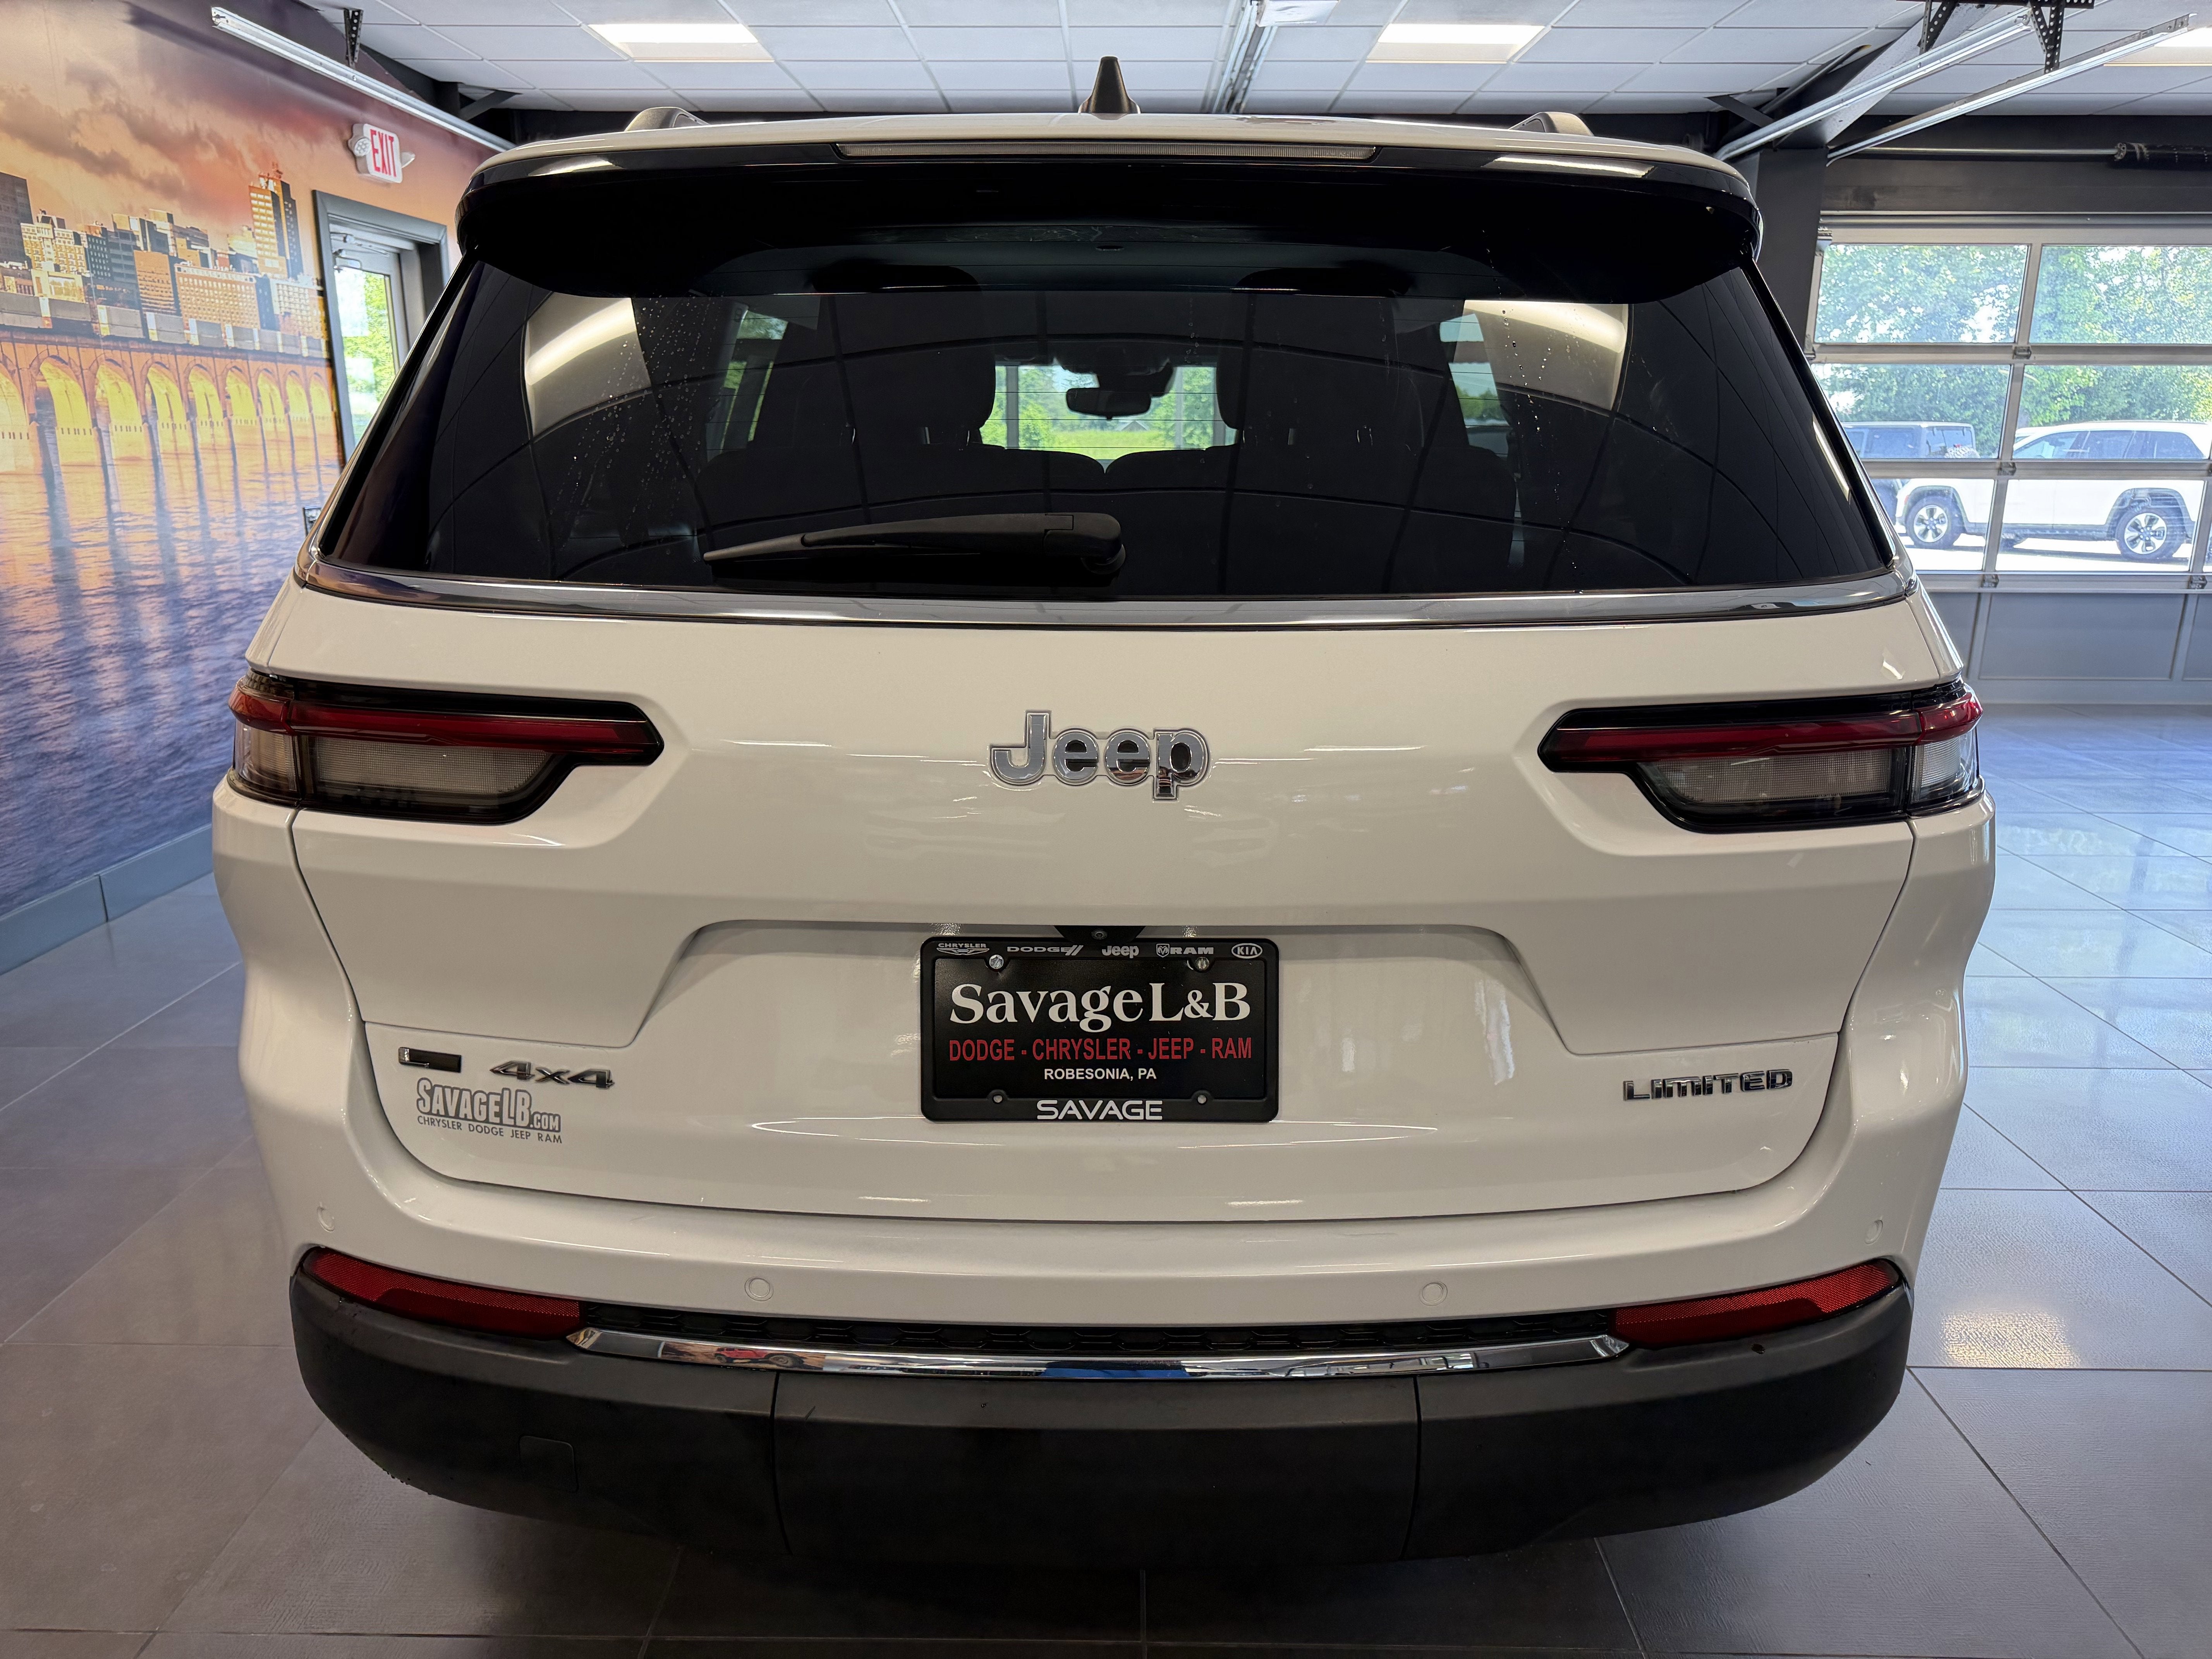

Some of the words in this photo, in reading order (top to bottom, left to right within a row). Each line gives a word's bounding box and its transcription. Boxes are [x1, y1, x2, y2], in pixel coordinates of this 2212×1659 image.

[370, 129, 397, 177] EXIT
[989, 710, 1210, 801] Jeep
[1102, 945, 1139, 958] Jeep
[1238, 946, 1258, 955] KIA
[949, 1039, 1015, 1061] DODGE
[1032, 1038, 1131, 1060] CHRYSLER
[1148, 1038, 1194, 1060] JEEP
[1212, 1037, 1252, 1059] RAM
[1044, 1068, 1133, 1081] ROBESONIA,
[1138, 1068, 1157, 1079] PA
[1623, 1069, 1793, 1101] LIMITED
[1037, 1100, 1163, 1120] SAVAGE
[417, 1116, 462, 1131] CHRYSLER
[468, 1124, 504, 1136] DODGE
[510, 1129, 531, 1140] JEEP
[537, 1133, 562, 1144] RAM
